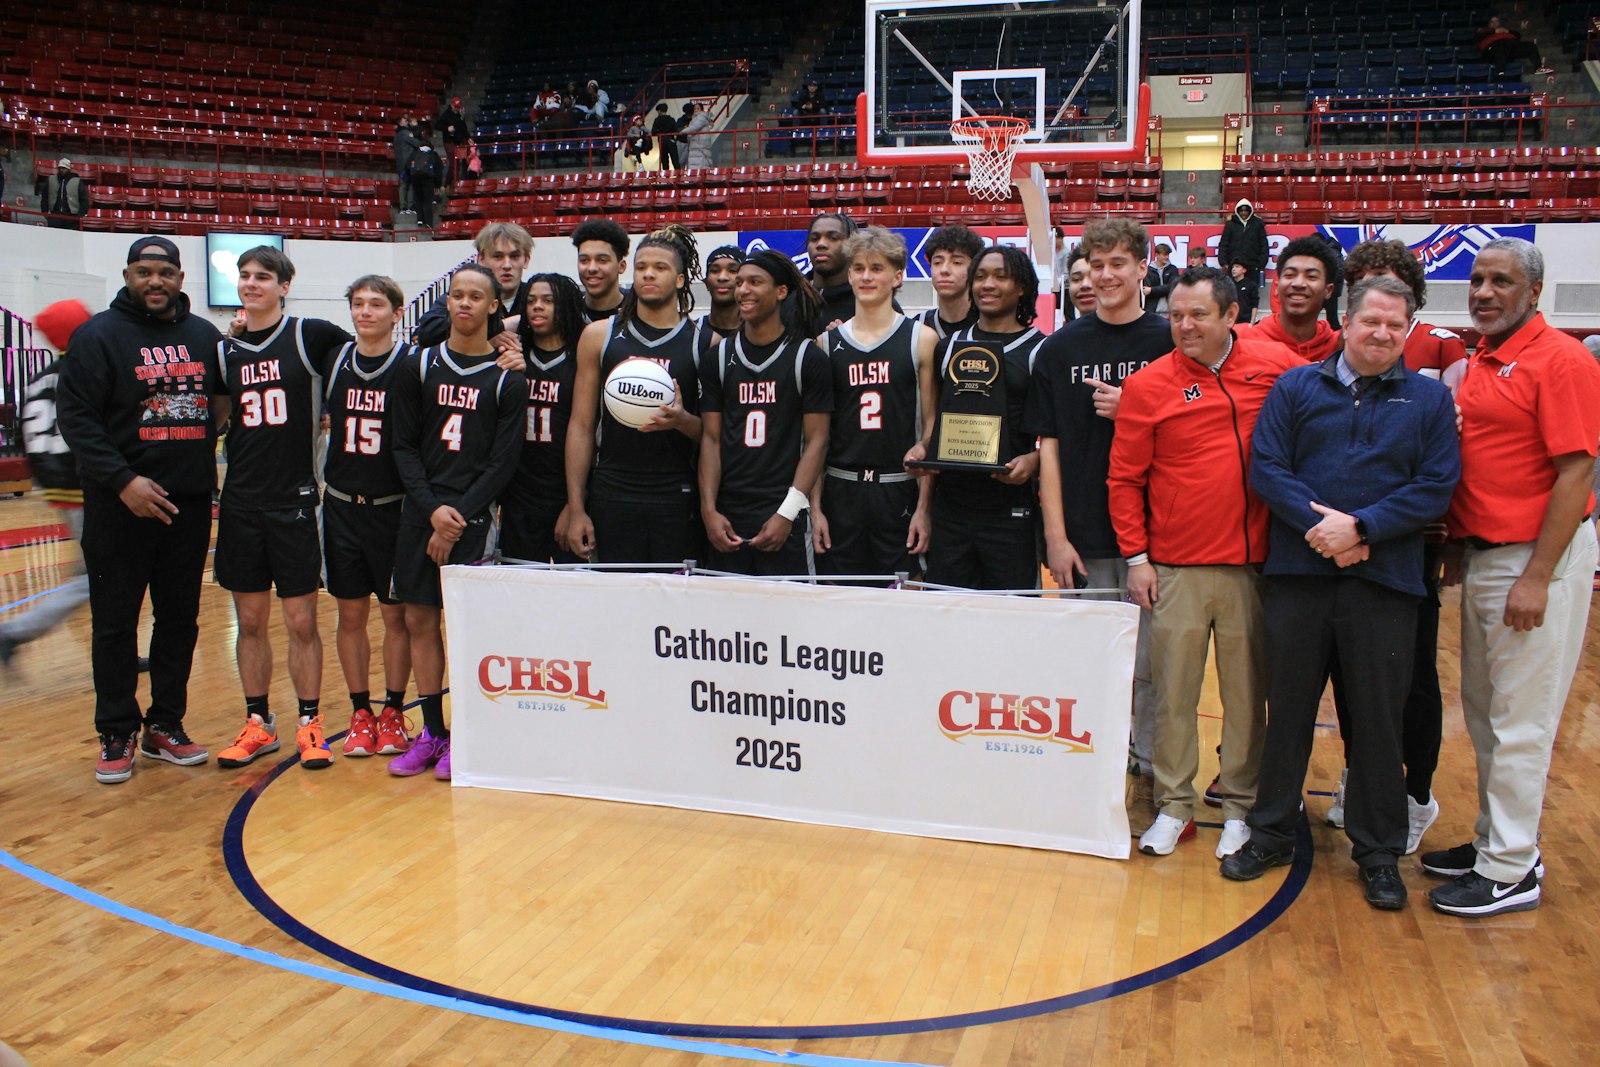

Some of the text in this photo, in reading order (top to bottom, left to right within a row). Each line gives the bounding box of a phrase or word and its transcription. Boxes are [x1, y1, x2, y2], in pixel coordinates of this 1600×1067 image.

[1275, 126, 1283, 136] E
[1188, 172, 1195, 182] D
[1187, 195, 1195, 206] C
[140, 345, 190, 365] 2024
[959, 359, 990, 372] CHSL
[135, 364, 168, 380] STATE
[241, 359, 281, 386] OLSM
[848, 361, 890, 387] OLSM
[1071, 362, 1112, 384] FEAR
[1497, 361, 1517, 378] M
[346, 388, 386, 412] OLSM
[438, 384, 480, 411] OLSM
[618, 381, 664, 401] Wilson
[738, 381, 777, 405] OLSM
[1183, 383, 1202, 402] M
[240, 388, 288, 428] 30
[860, 390, 882, 430] 2
[139, 427, 168, 440] OLSM
[440, 413, 464, 451] 4
[526, 405, 552, 442] 11
[744, 410, 767, 448] 0
[344, 416, 382, 455] 15
[948, 448, 988, 458] CHAMPION
[863, 470, 874, 482] M
[356, 494, 366, 505] M
[654, 625, 884, 681] Catholic League
[478, 655, 606, 703] CHSL
[517, 700, 567, 712] EST.1926
[691, 680, 846, 726] Champions
[938, 690, 1092, 746] CHSL
[736, 736, 801, 772] 2025
[985, 741, 1044, 756] EST.1926
